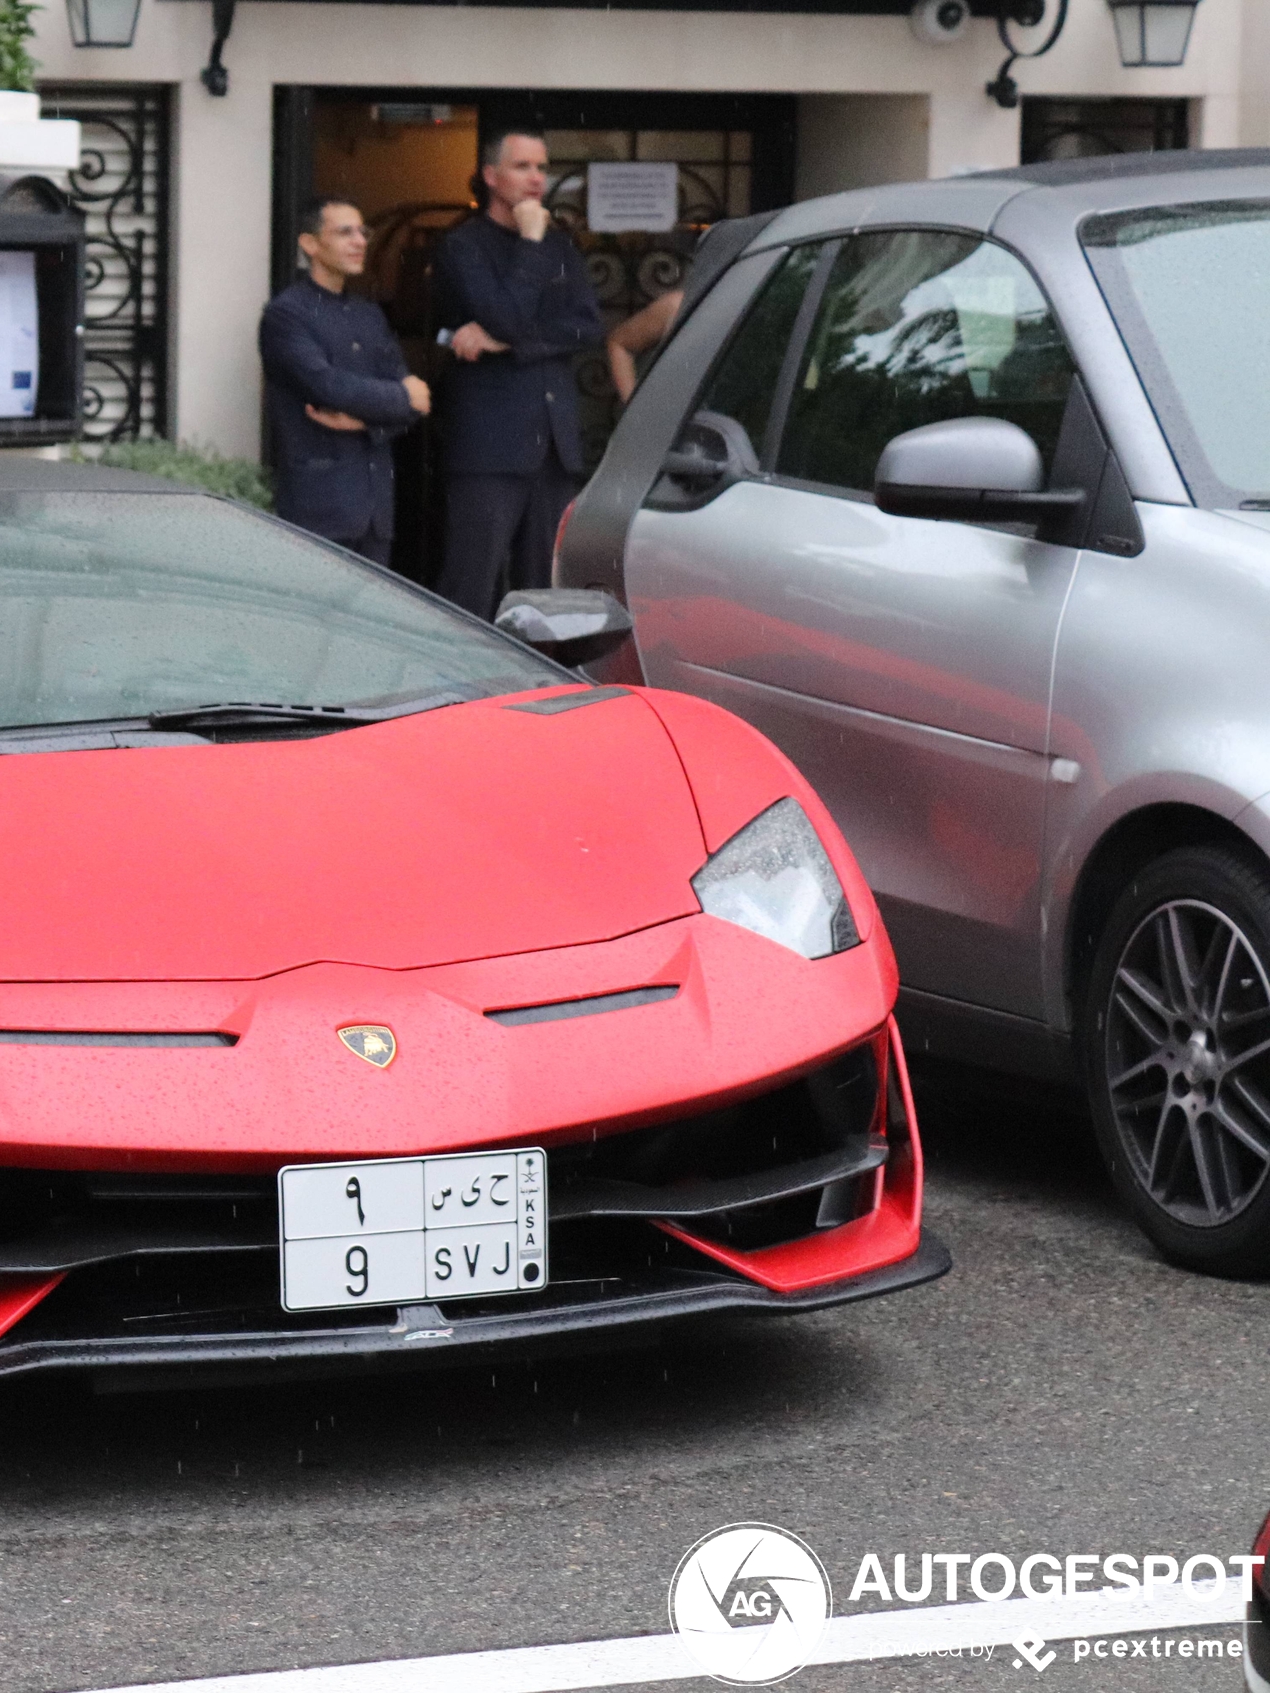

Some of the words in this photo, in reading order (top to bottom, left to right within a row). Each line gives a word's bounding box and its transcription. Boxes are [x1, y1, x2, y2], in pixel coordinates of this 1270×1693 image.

[525, 1199, 536, 1246] KSA
[345, 1245, 368, 1297] 9
[434, 1240, 510, 1281] SVJ
